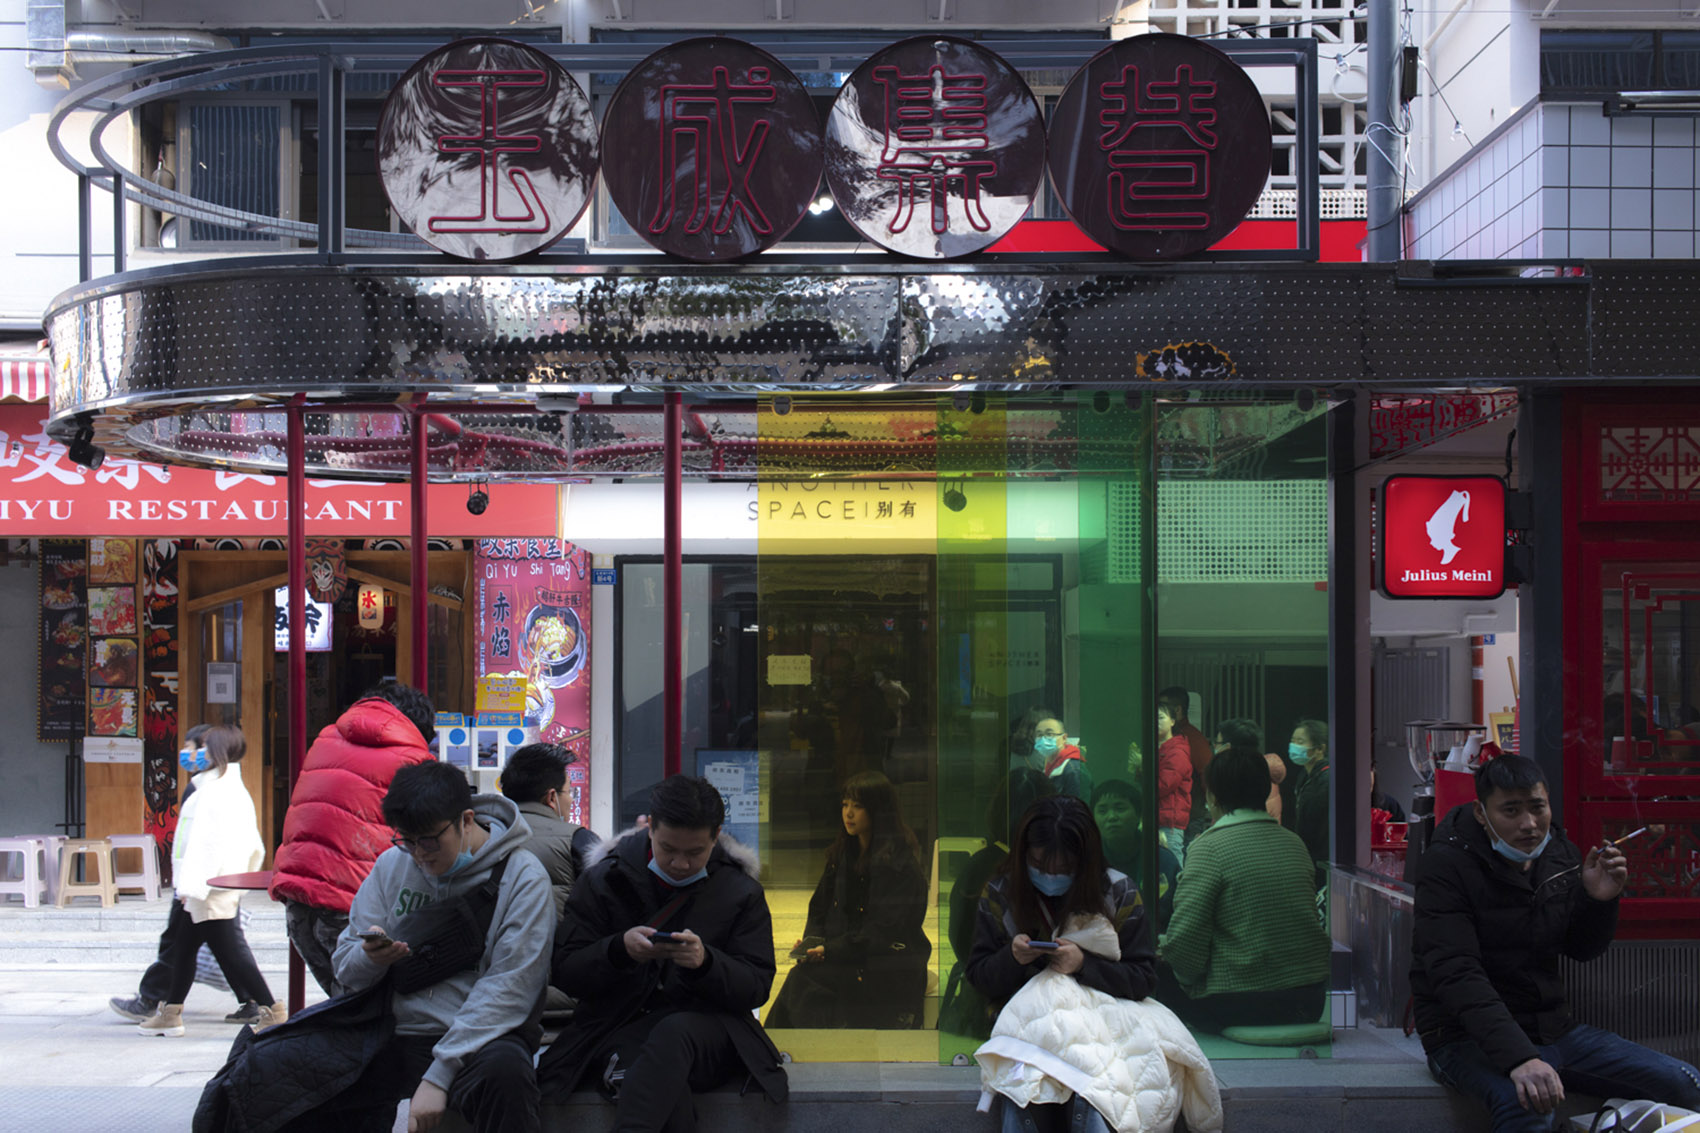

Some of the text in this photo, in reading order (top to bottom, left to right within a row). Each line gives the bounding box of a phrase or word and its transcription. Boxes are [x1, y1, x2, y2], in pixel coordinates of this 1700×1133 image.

[748, 500, 917, 520] SPACE 别有
[485, 563, 498, 579] Qi
[529, 563, 544, 576] Shi
[1401, 569, 1493, 583] Julius Meinl
